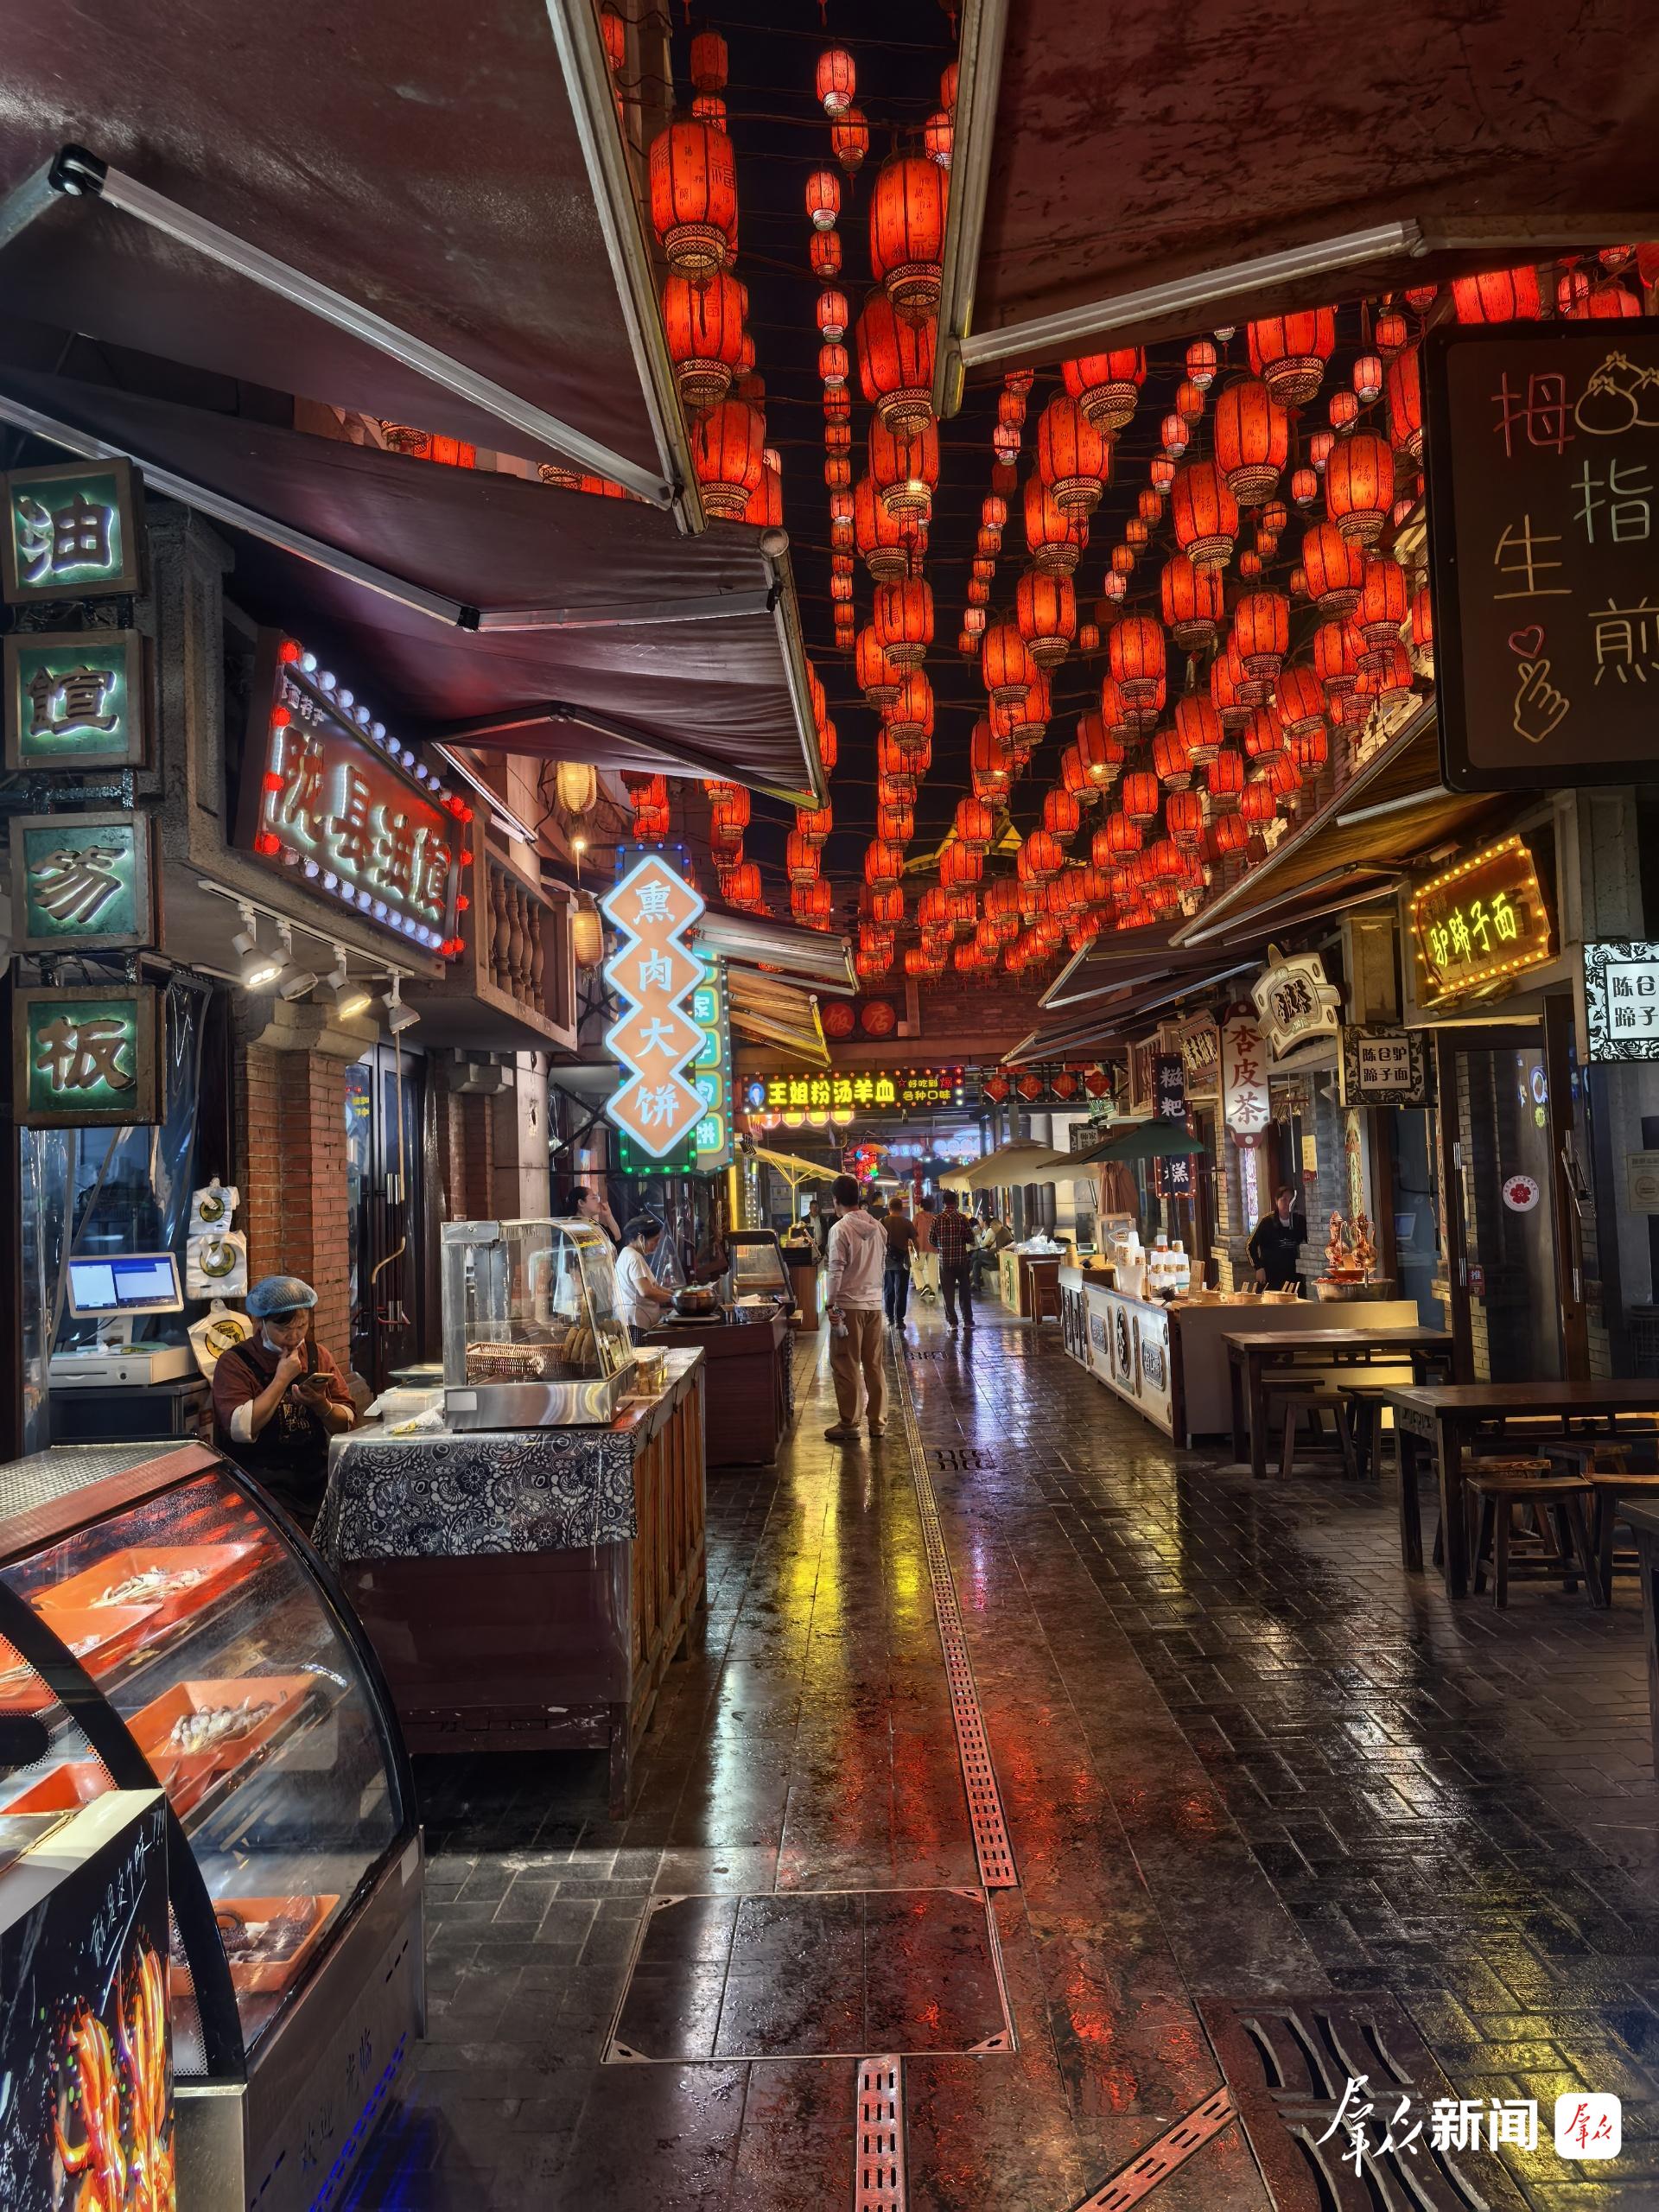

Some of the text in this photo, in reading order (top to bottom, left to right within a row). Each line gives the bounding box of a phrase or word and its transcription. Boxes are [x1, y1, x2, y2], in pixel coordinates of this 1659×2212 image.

[1430, 892, 1517, 968] 驴蹄子面
[632, 880, 680, 1128] 熏肉大饼
[827, 1006, 889, 1033] 饭店
[1363, 1046, 1407, 1062] 陈仓驴
[1227, 1025, 1268, 1126] 杏皮茶
[1363, 1067, 1408, 1082] 蹄子面
[768, 1078, 895, 1105] 王姐粉汤羊血
[902, 1089, 951, 1101] 各种口味
[1160, 1065, 1190, 1184] 糍粑糕
